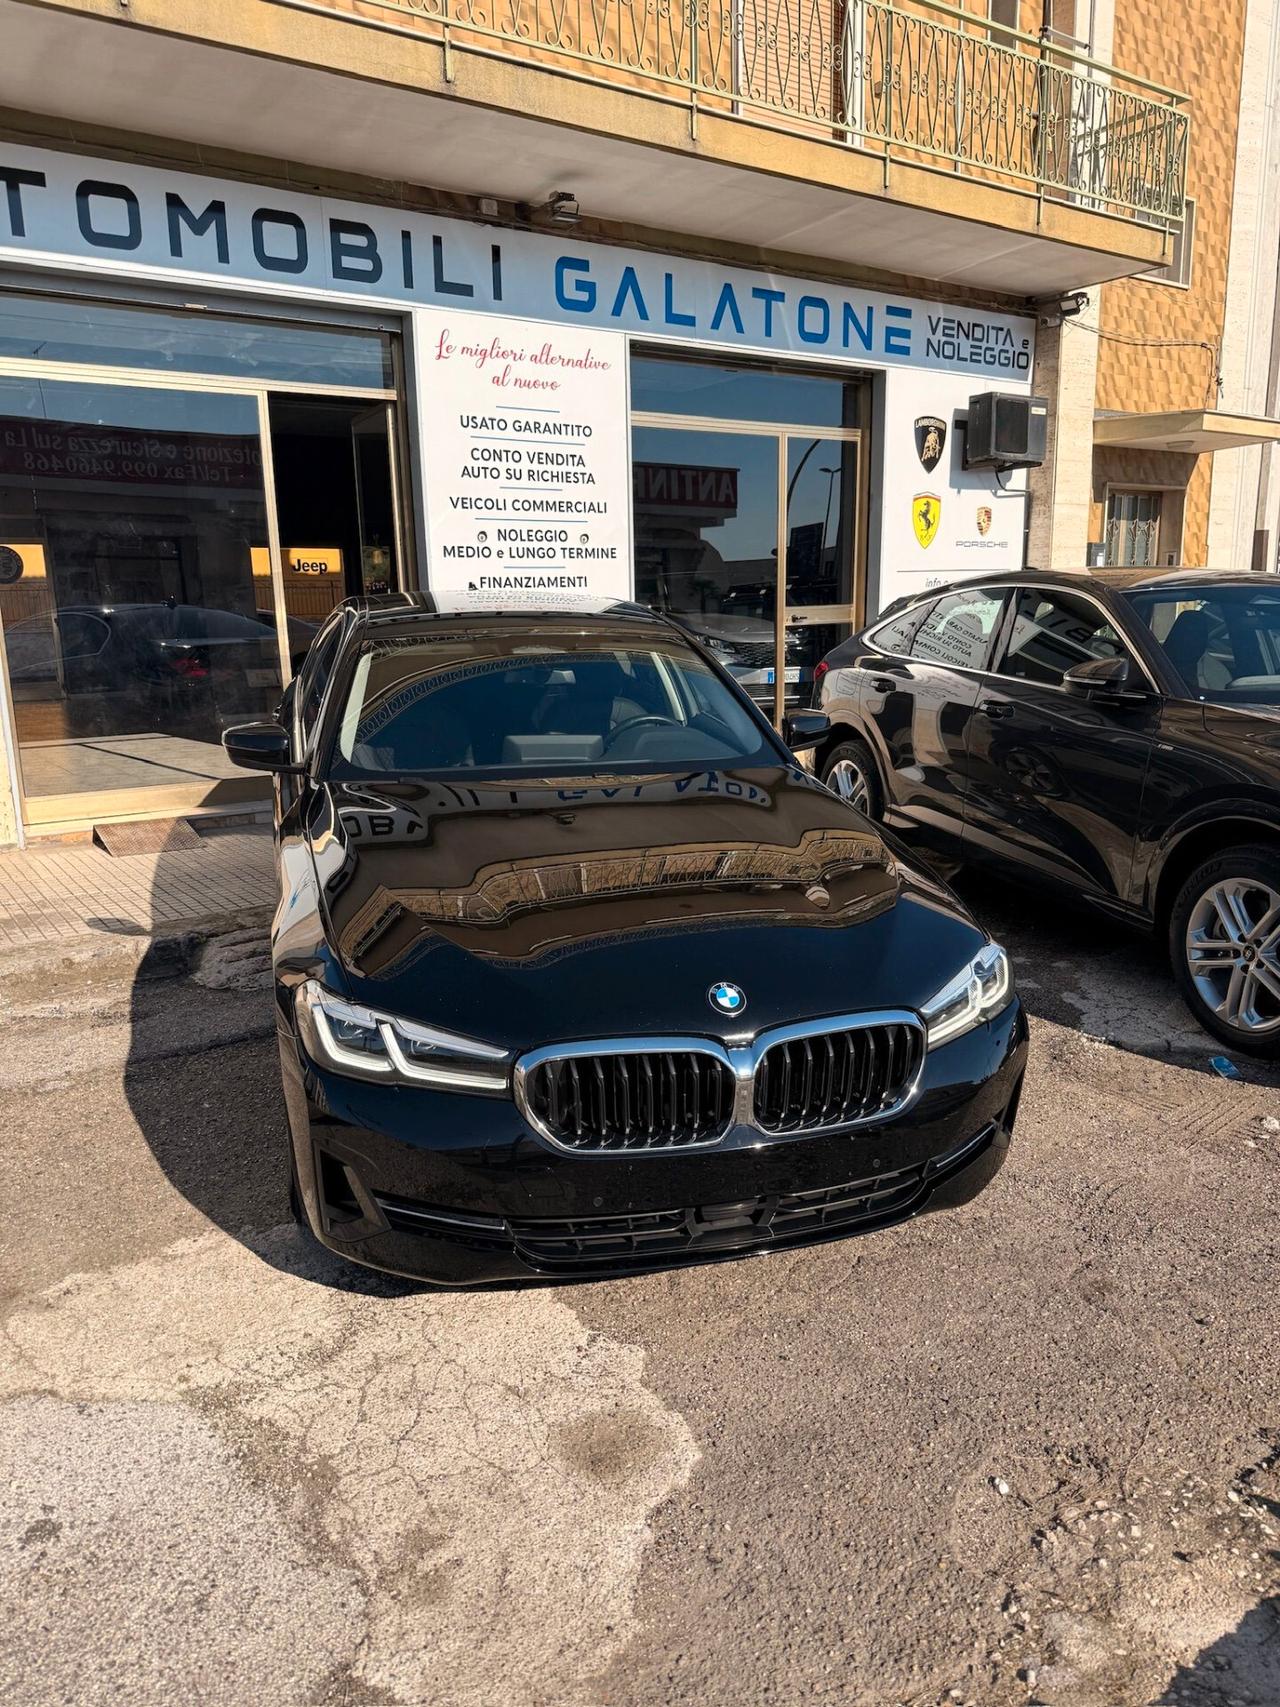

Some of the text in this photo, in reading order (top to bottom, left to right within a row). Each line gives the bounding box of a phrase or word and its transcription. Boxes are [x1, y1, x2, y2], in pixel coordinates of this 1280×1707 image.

[554, 255, 912, 356] GALATONE
[927, 314, 1030, 350] VENDITA e
[434, 328, 613, 371] Le migliori alternative
[925, 337, 1030, 370] NOLEGGIO
[491, 363, 562, 391] al nuovo
[459, 414, 593, 438] USATO GARANTITO
[470, 447, 586, 468] CONTO VENDITA
[460, 465, 596, 485] AUTO SU RICHIESTA
[449, 496, 607, 514] VEICOLI COMMERCIALI
[496, 528, 569, 543] NOLEGGIO
[955, 540, 1009, 549] PORSCHE
[442, 545, 617, 560] MEDIO e LUNGO TERMINE
[291, 558, 328, 575] Jeep
[479, 575, 588, 589] FINANZIAMENTI
